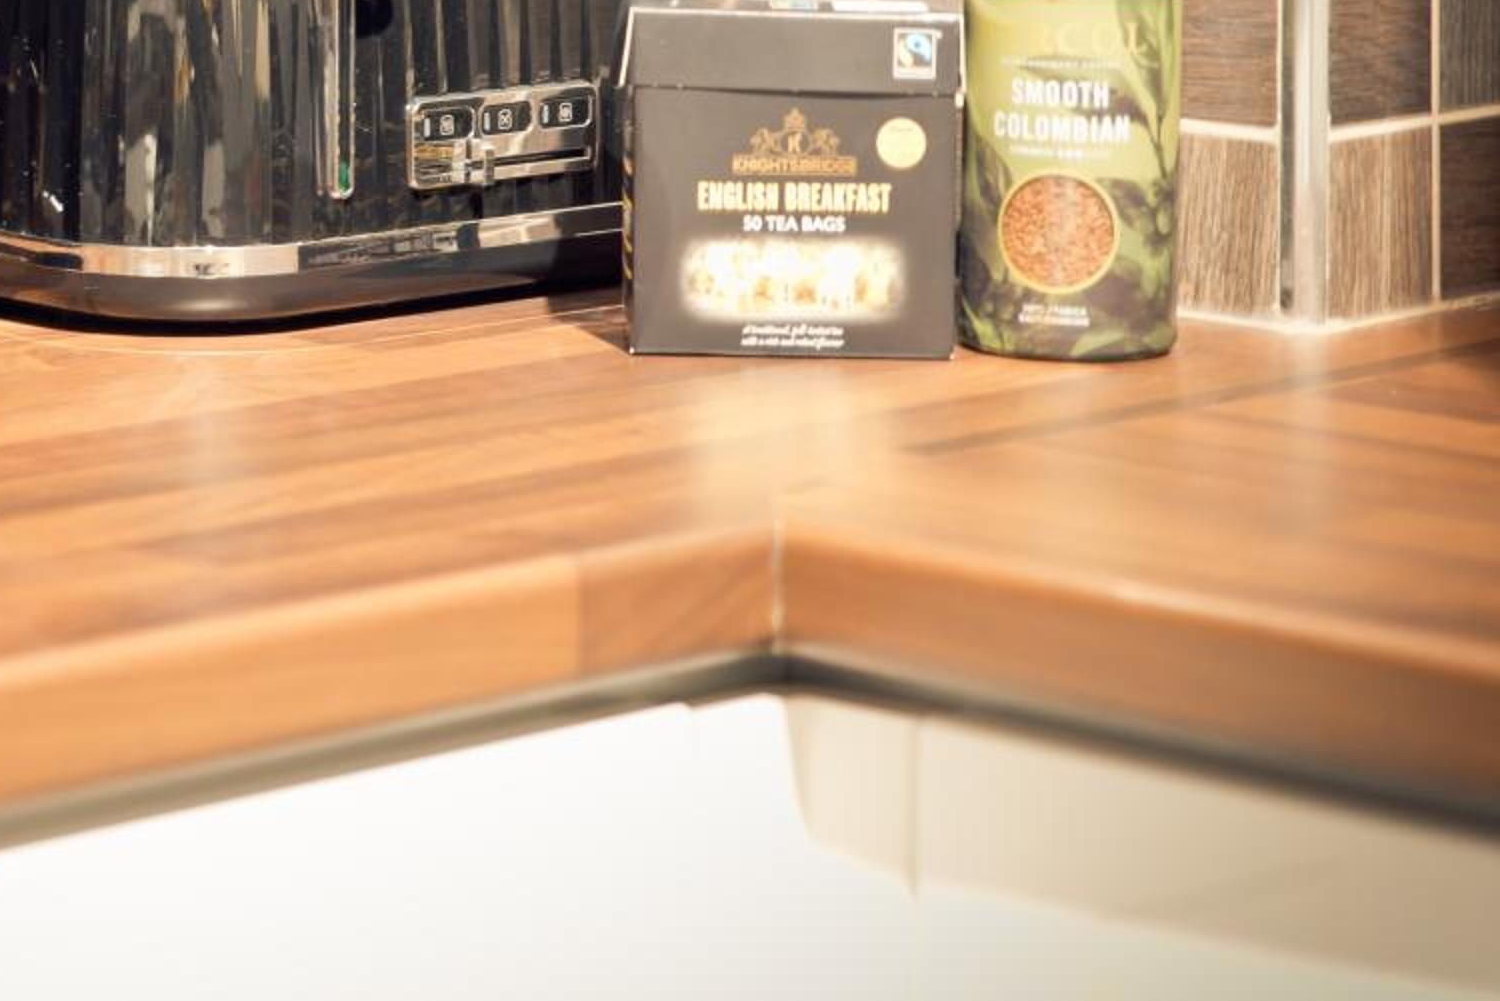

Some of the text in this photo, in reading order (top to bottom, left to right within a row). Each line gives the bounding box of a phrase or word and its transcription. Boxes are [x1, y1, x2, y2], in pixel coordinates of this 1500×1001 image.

[1011, 78, 1110, 109] SMOOTH
[994, 110, 1131, 142] COLOMBIAN
[698, 181, 892, 214] ENGLISH BREAKFAST
[743, 215, 846, 232] 50 TEA BAGS
